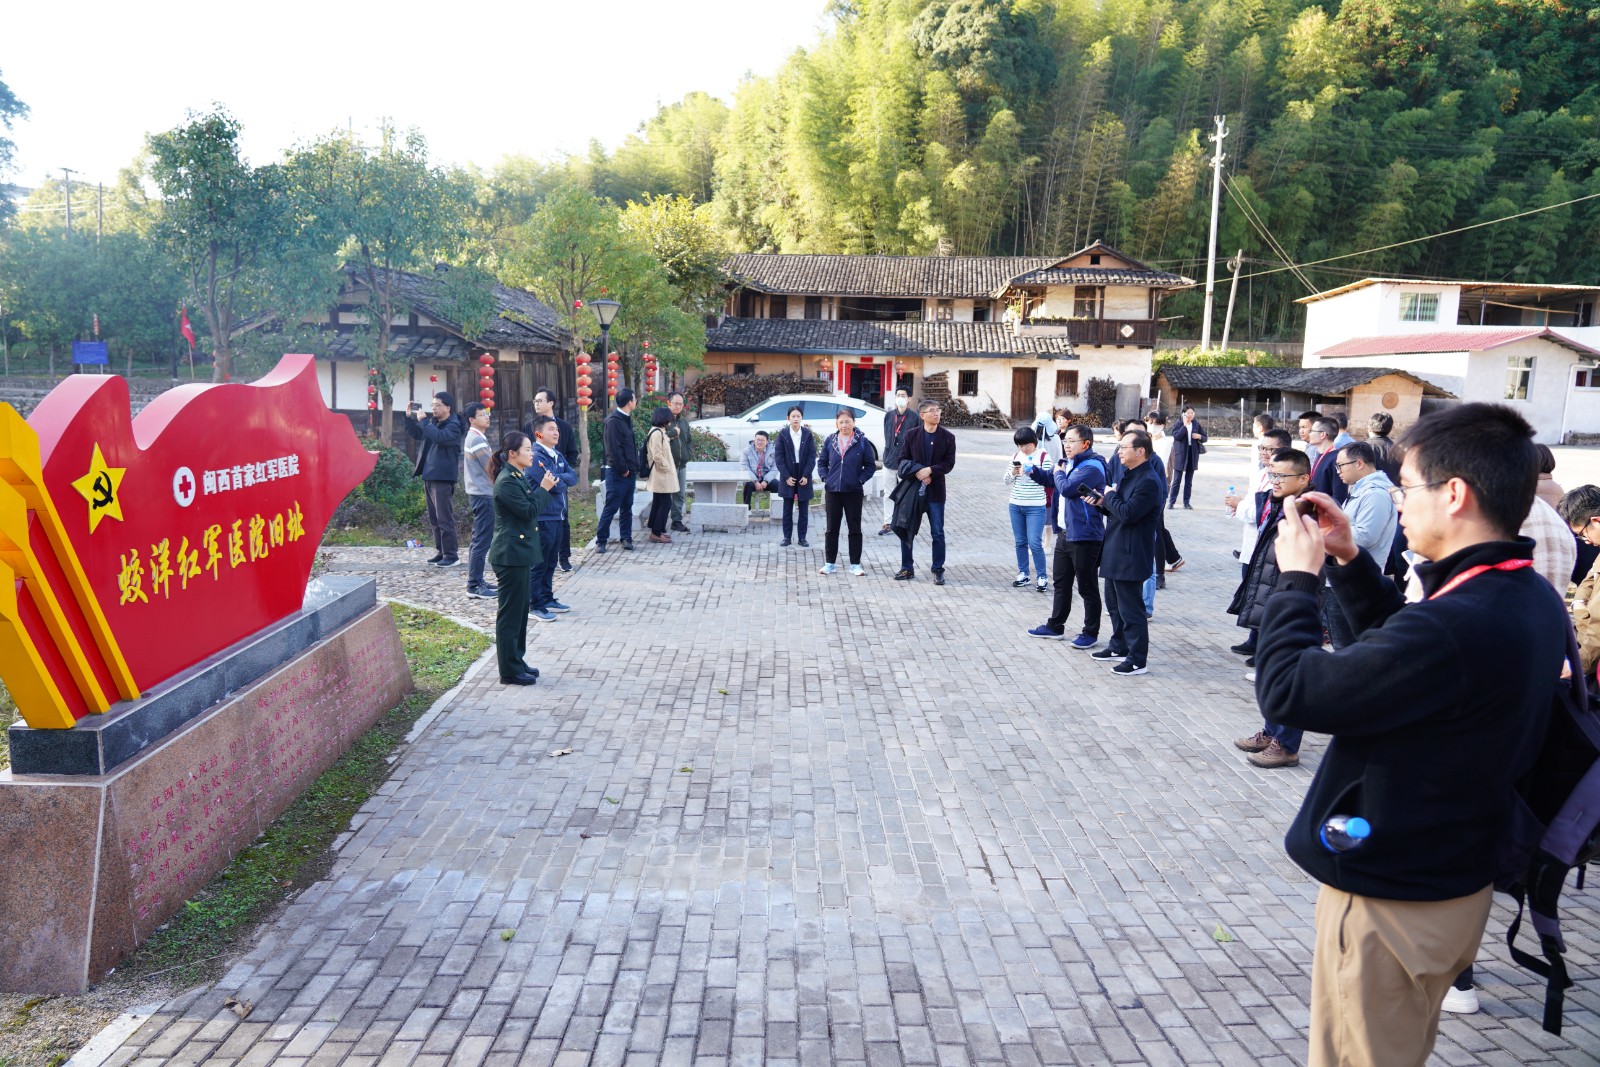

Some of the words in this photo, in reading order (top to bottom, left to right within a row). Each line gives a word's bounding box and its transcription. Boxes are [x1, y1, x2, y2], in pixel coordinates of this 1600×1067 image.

[203, 454, 300, 496] 闽西首家红军医院
[117, 500, 306, 606] 蛟洋红军医院旧址
